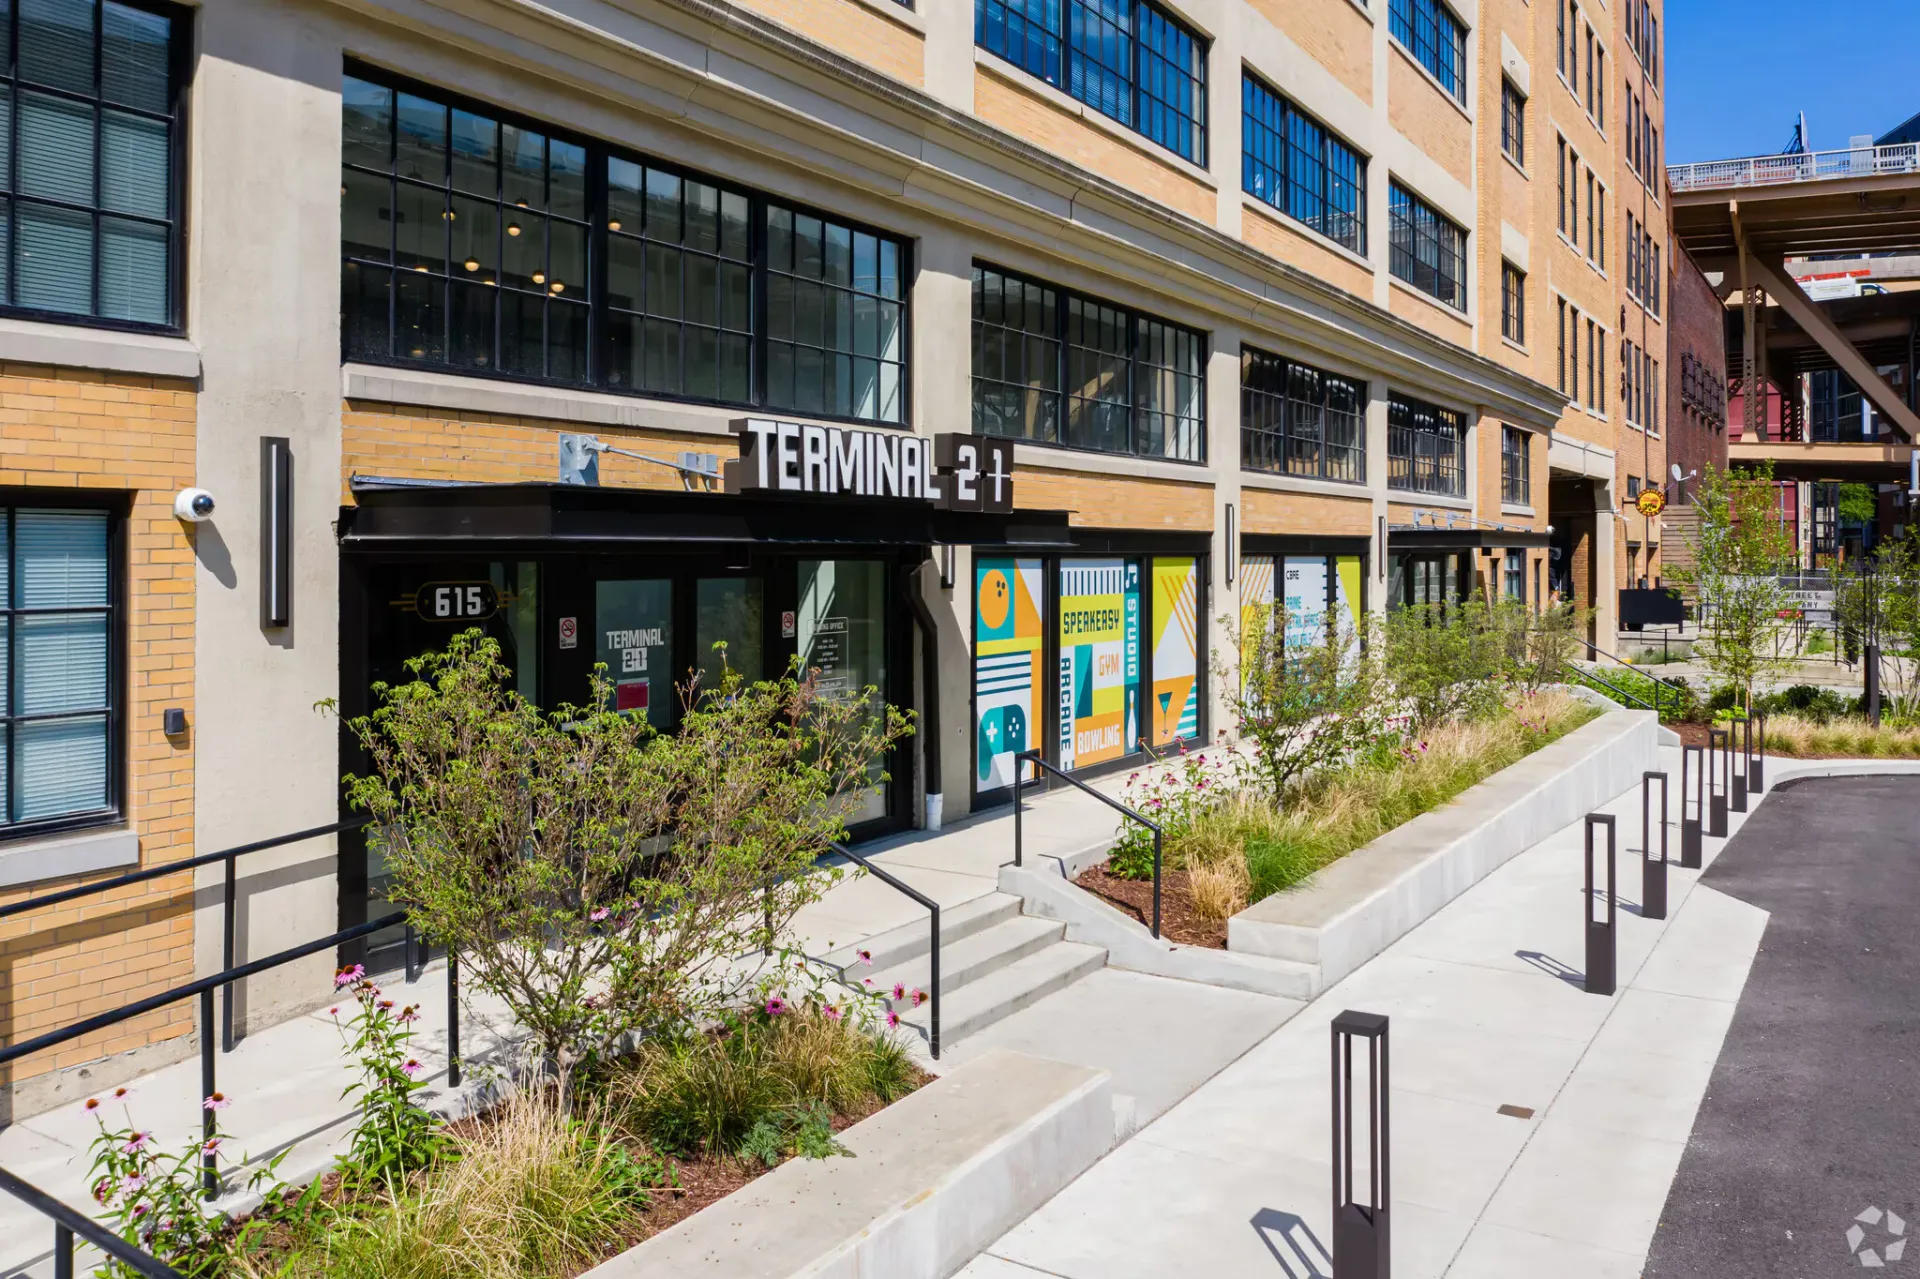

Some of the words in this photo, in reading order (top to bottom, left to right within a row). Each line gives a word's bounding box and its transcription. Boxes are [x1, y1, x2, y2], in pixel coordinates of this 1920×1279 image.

[747, 418, 941, 499] TERMINAL
[958, 444, 1001, 502] 21
[1286, 570, 1300, 580] CBRE
[435, 586, 481, 617] 615
[1780, 601, 1819, 609] OMANY
[1063, 609, 1120, 634] SPEAKEASY
[606, 628, 665, 650] TERMINAL
[1127, 598, 1137, 677] STUDIO
[624, 650, 645, 669] 21
[1098, 653, 1120, 677] GYM
[1060, 657, 1072, 752] ARCADE
[1077, 724, 1121, 755] BOWLING
